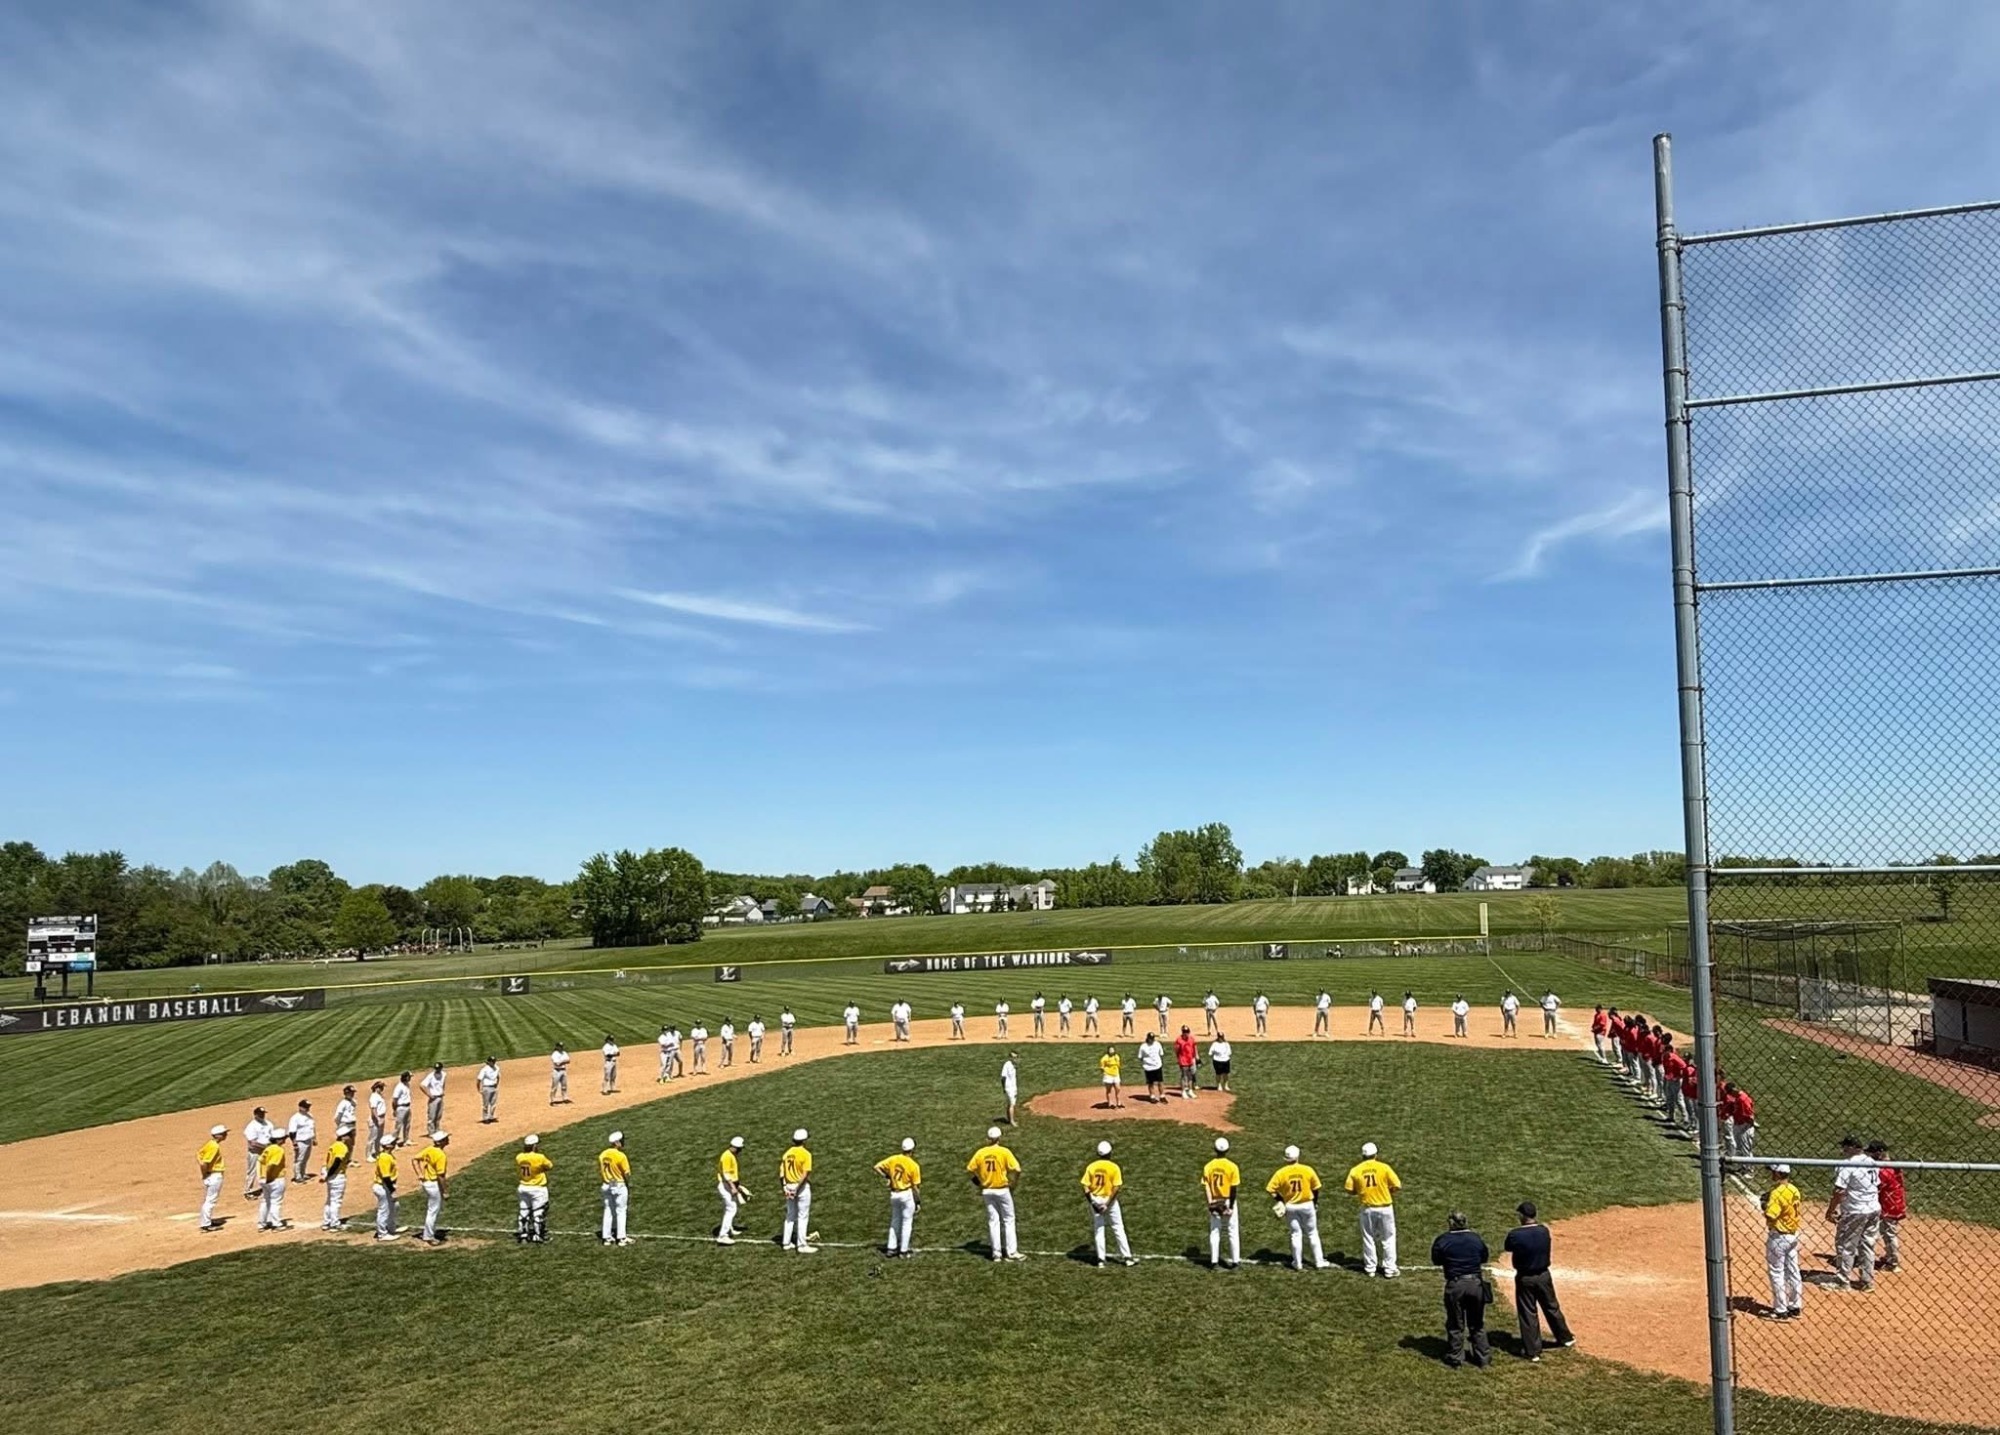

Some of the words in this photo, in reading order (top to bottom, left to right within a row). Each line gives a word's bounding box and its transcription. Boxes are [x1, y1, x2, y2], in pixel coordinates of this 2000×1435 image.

[926, 957, 957, 970] HOME
[964, 956, 977, 969] OF
[984, 954, 1005, 968] THE
[1012, 952, 1071, 966] WARRIORS
[43, 1004, 135, 1028] LEBANON
[149, 997, 243, 1019] BASEBALL
[985, 1160, 996, 1172] 71
[1094, 1174, 1105, 1187] 71
[1213, 1173, 1223, 1187] 71
[1290, 1180, 1302, 1192] 71
[1364, 1174, 1377, 1188] 71
